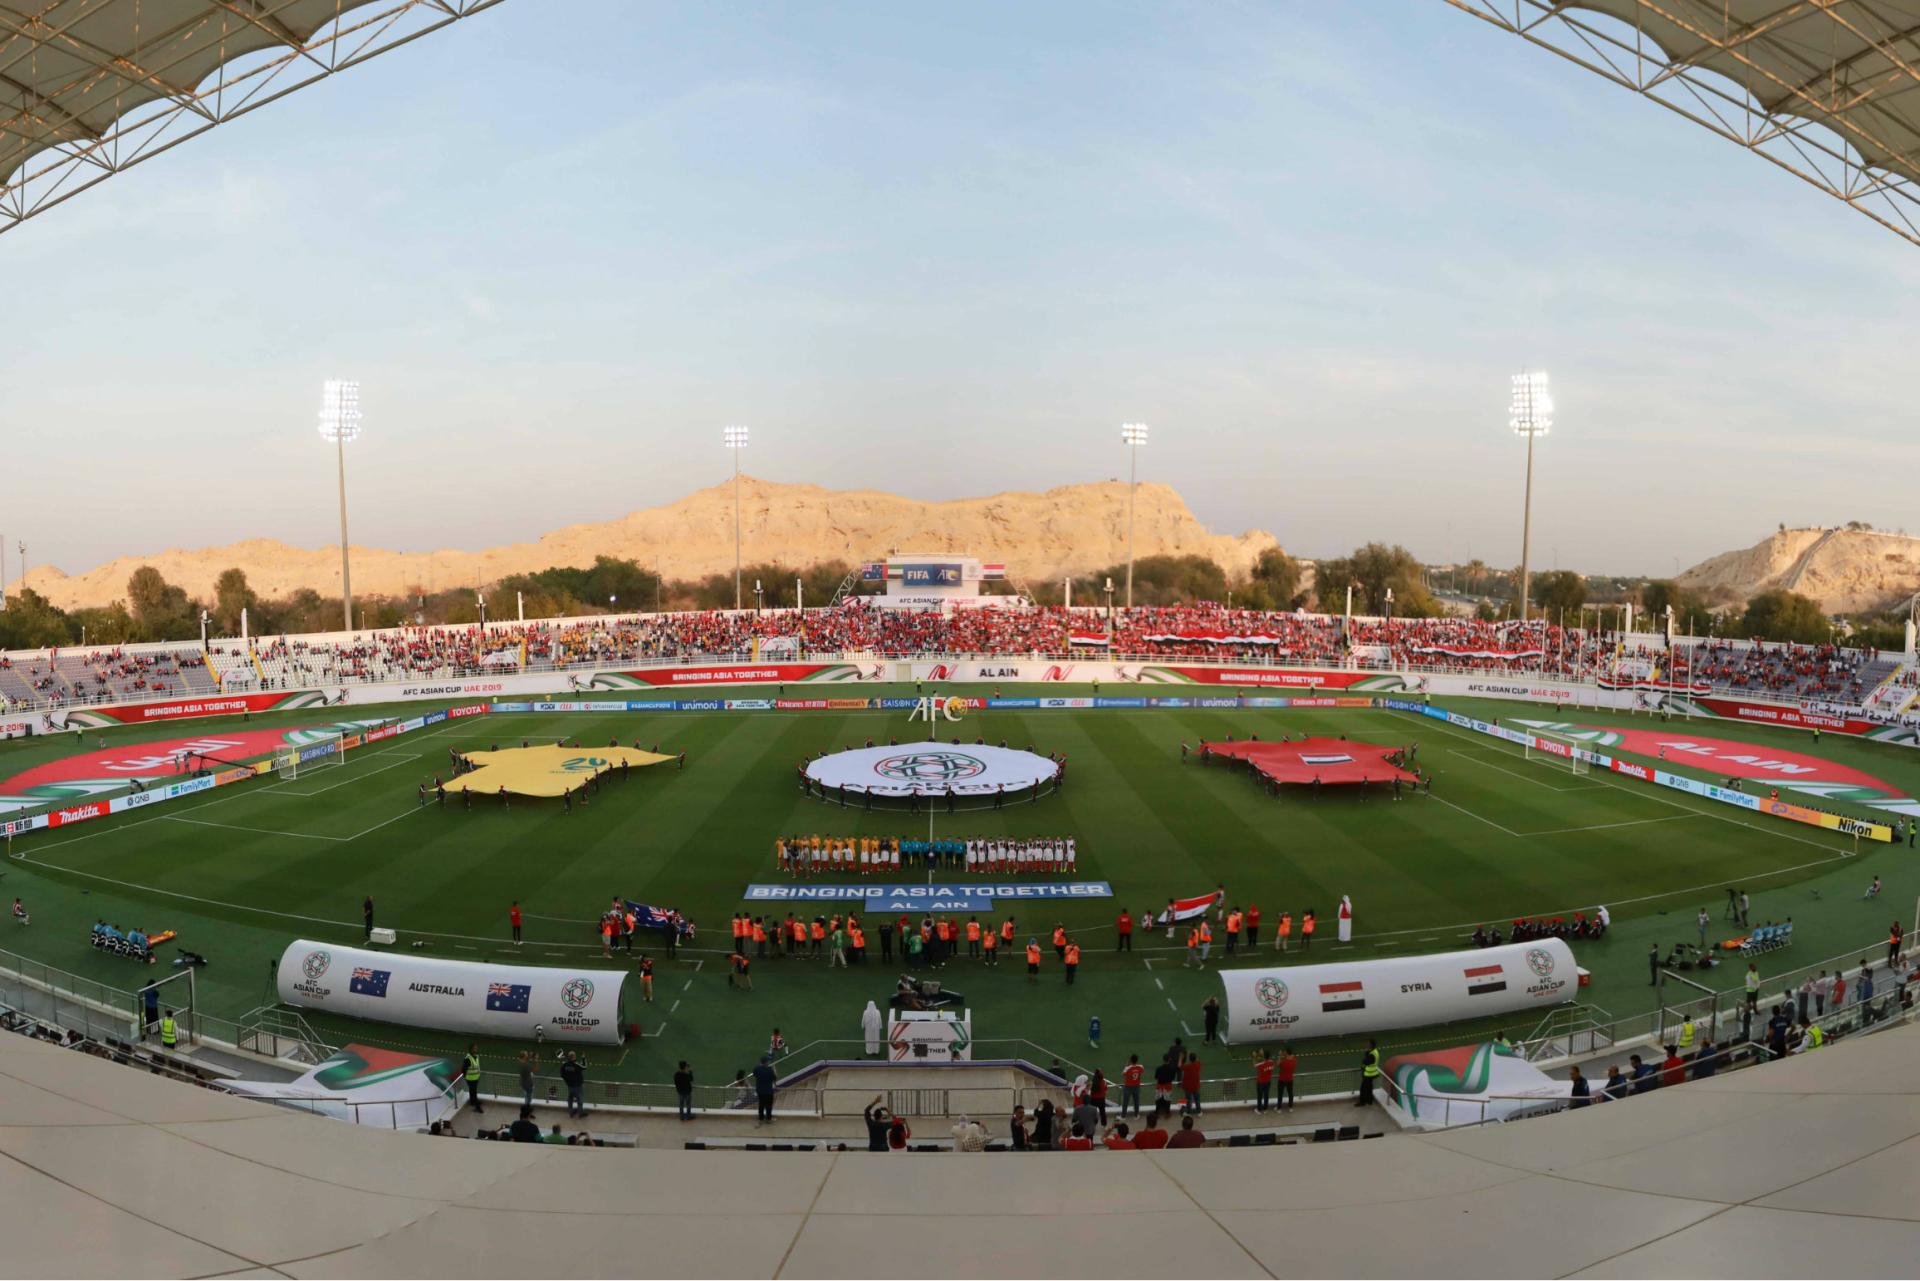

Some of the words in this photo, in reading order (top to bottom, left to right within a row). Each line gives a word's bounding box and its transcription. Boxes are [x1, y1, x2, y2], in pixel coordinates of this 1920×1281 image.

[908, 570, 929, 580] FIFA
[672, 672, 711, 680] BRINGING
[979, 668, 995, 677] AL
[998, 668, 1018, 677] AIN
[420, 687, 444, 695] ASIAN
[1486, 685, 1510, 694] ASIAN
[144, 706, 182, 716] BRINGING
[184, 704, 202, 712] ASIA
[204, 701, 246, 711] TOGETHER
[682, 700, 718, 710] unimoni
[908, 696, 963, 722] AFC
[452, 706, 482, 717] TOYOTA
[1739, 708, 1777, 719] BRINGING
[1781, 712, 1800, 721] ASIA
[1802, 715, 1844, 728] TOGETHER
[7, 723, 25, 731] 2019
[1540, 739, 1565, 756] TOYOTA
[1655, 742, 1717, 756] AL
[1715, 755, 1818, 774] AIN
[271, 759, 289, 770] Nikon
[180, 778, 211, 794] FamilyMart
[1676, 777, 1689, 789] QNB
[134, 793, 149, 804] QNB
[1720, 789, 1753, 807] FamilyMart
[1838, 818, 1872, 836] Nikon
[752, 887, 883, 897] BRINGING
[890, 887, 953, 896] ASIA
[959, 885, 1105, 896] TOGETHER
[890, 901, 919, 909] AL
[932, 900, 969, 909] AIN
[293, 983, 314, 993] ASIAN
[316, 987, 330, 995] CUP
[408, 982, 465, 996] AUSTRALIA
[1401, 982, 1432, 993] SYRIA
[1527, 984, 1549, 992] ASIAN
[1550, 980, 1565, 989] CUP
[552, 1017, 579, 1025] ASIAN
[581, 1018, 600, 1026] CUP
[1250, 1017, 1278, 1025] ASIAN
[1281, 1015, 1299, 1023] CUP
